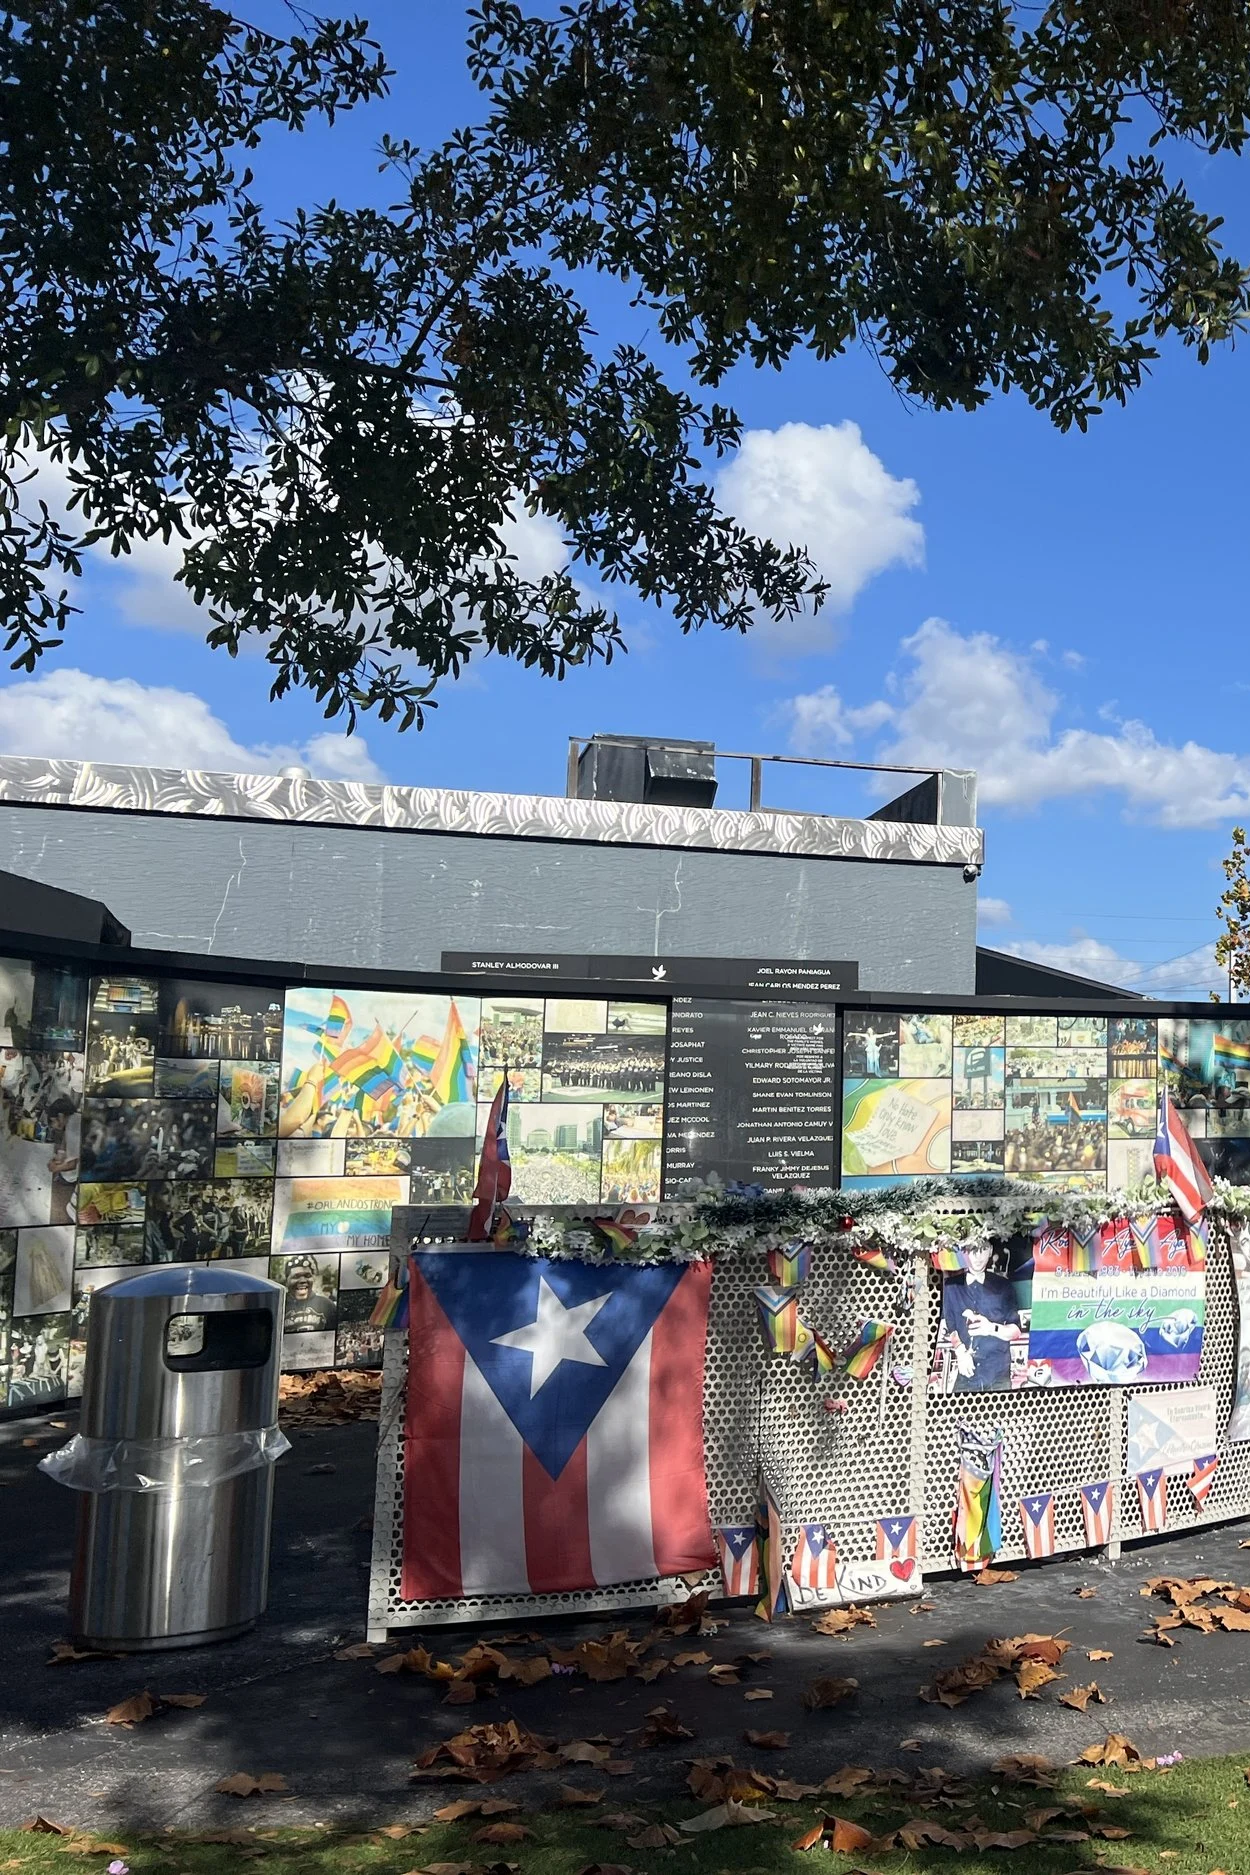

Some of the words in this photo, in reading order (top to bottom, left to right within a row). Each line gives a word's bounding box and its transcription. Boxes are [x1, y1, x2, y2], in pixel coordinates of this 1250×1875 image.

[472, 961, 504, 969] STANLEY
[505, 962, 552, 970] ALMODOVAR
[680, 1086, 714, 1094] LEINONEN
[678, 1131, 716, 1139] MEENDEZ
[747, 1136, 765, 1144] JUAN
[768, 1150, 782, 1158] LUIS
[752, 1165, 779, 1173] FRANKY
[771, 1172, 811, 1180] VELAZQUEZ
[320, 1222, 337, 1235] MY
[346, 1234, 361, 1247] MY
[363, 1233, 391, 1247] HOME
[1040, 1287, 1059, 1299] I'm
[1062, 1286, 1113, 1299] Beautiful
[1115, 1286, 1138, 1299] Like
[1140, 1289, 1148, 1298] a
[1151, 1286, 1198, 1298] Diamond
[1067, 1307, 1090, 1321] in
[1081, 1298, 1124, 1320] the
[1128, 1299, 1168, 1334] sky
